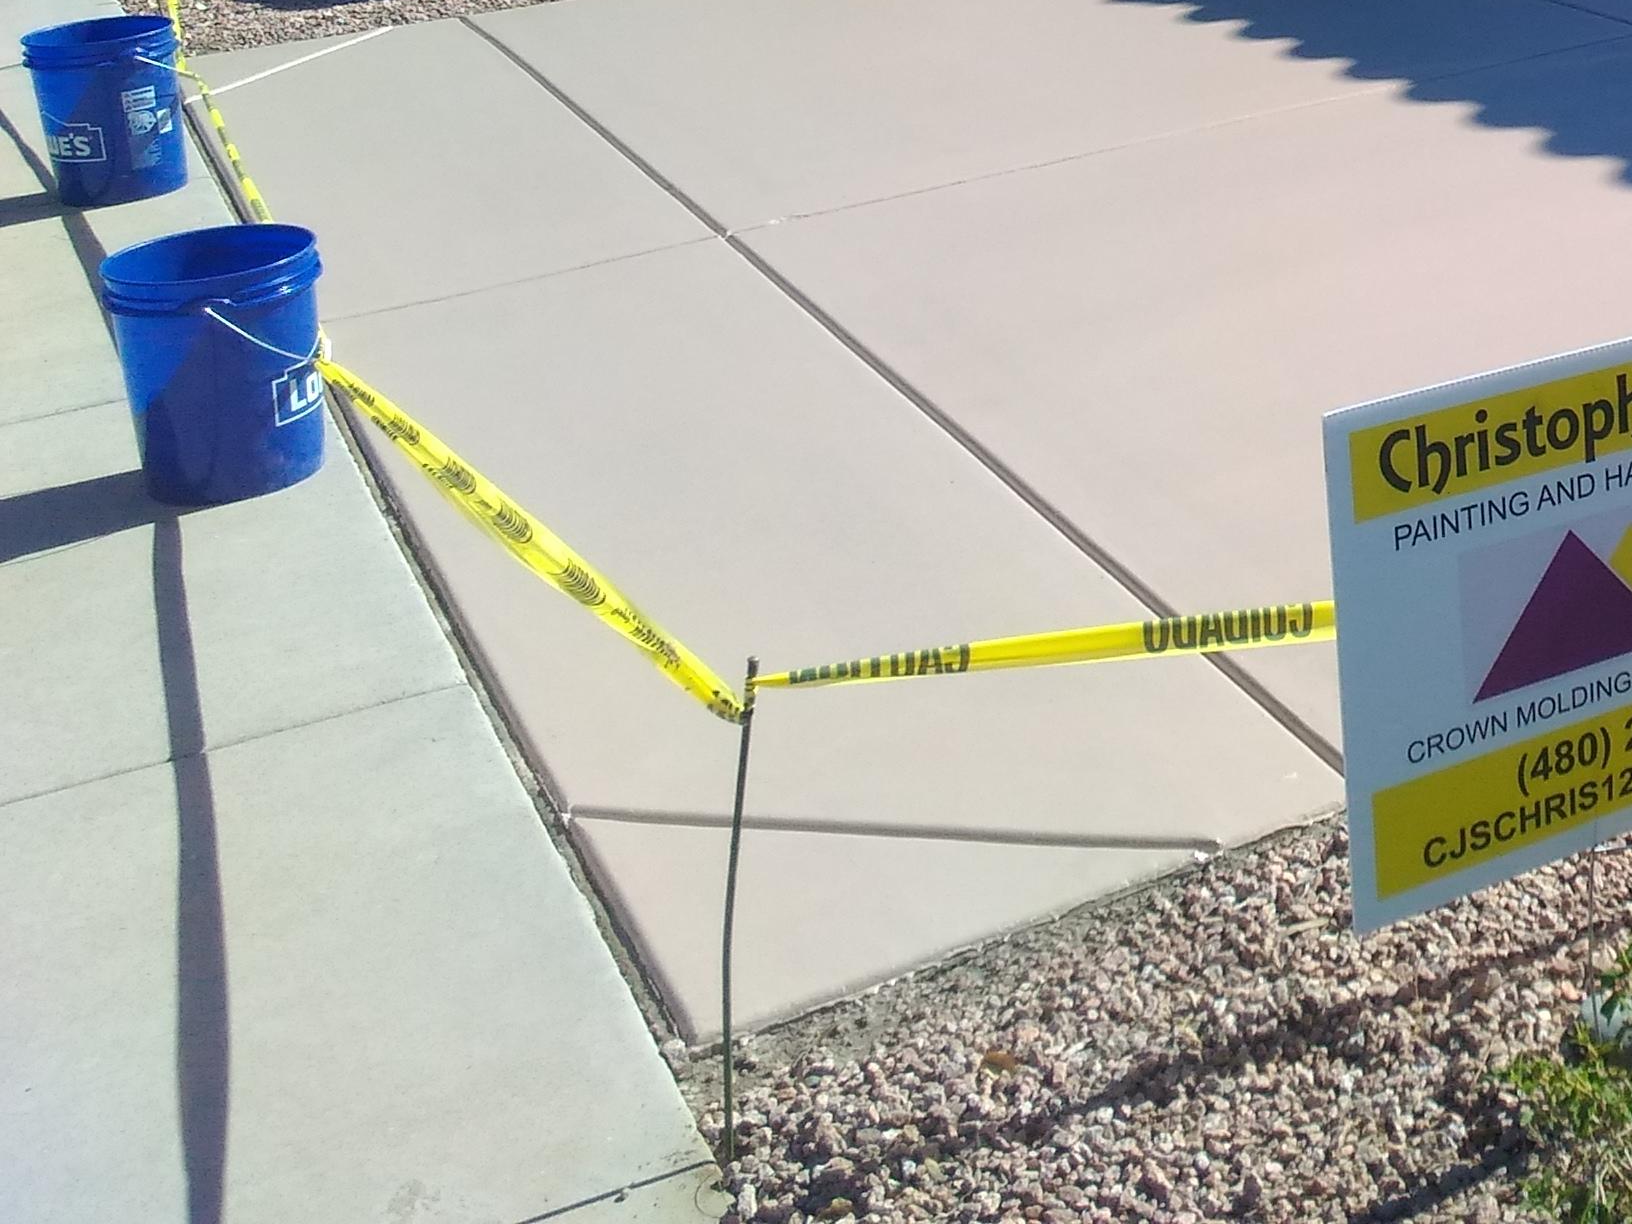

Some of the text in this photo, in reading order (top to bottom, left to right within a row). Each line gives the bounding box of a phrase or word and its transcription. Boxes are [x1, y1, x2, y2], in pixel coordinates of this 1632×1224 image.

[290, 371, 323, 412] LO
[1394, 491, 1530, 551] PAINTING
[1537, 473, 1596, 511] AND
[1407, 712, 1508, 764] CROWN
[1516, 672, 1632, 728] MOLDING
[1517, 727, 1612, 797] (480)
